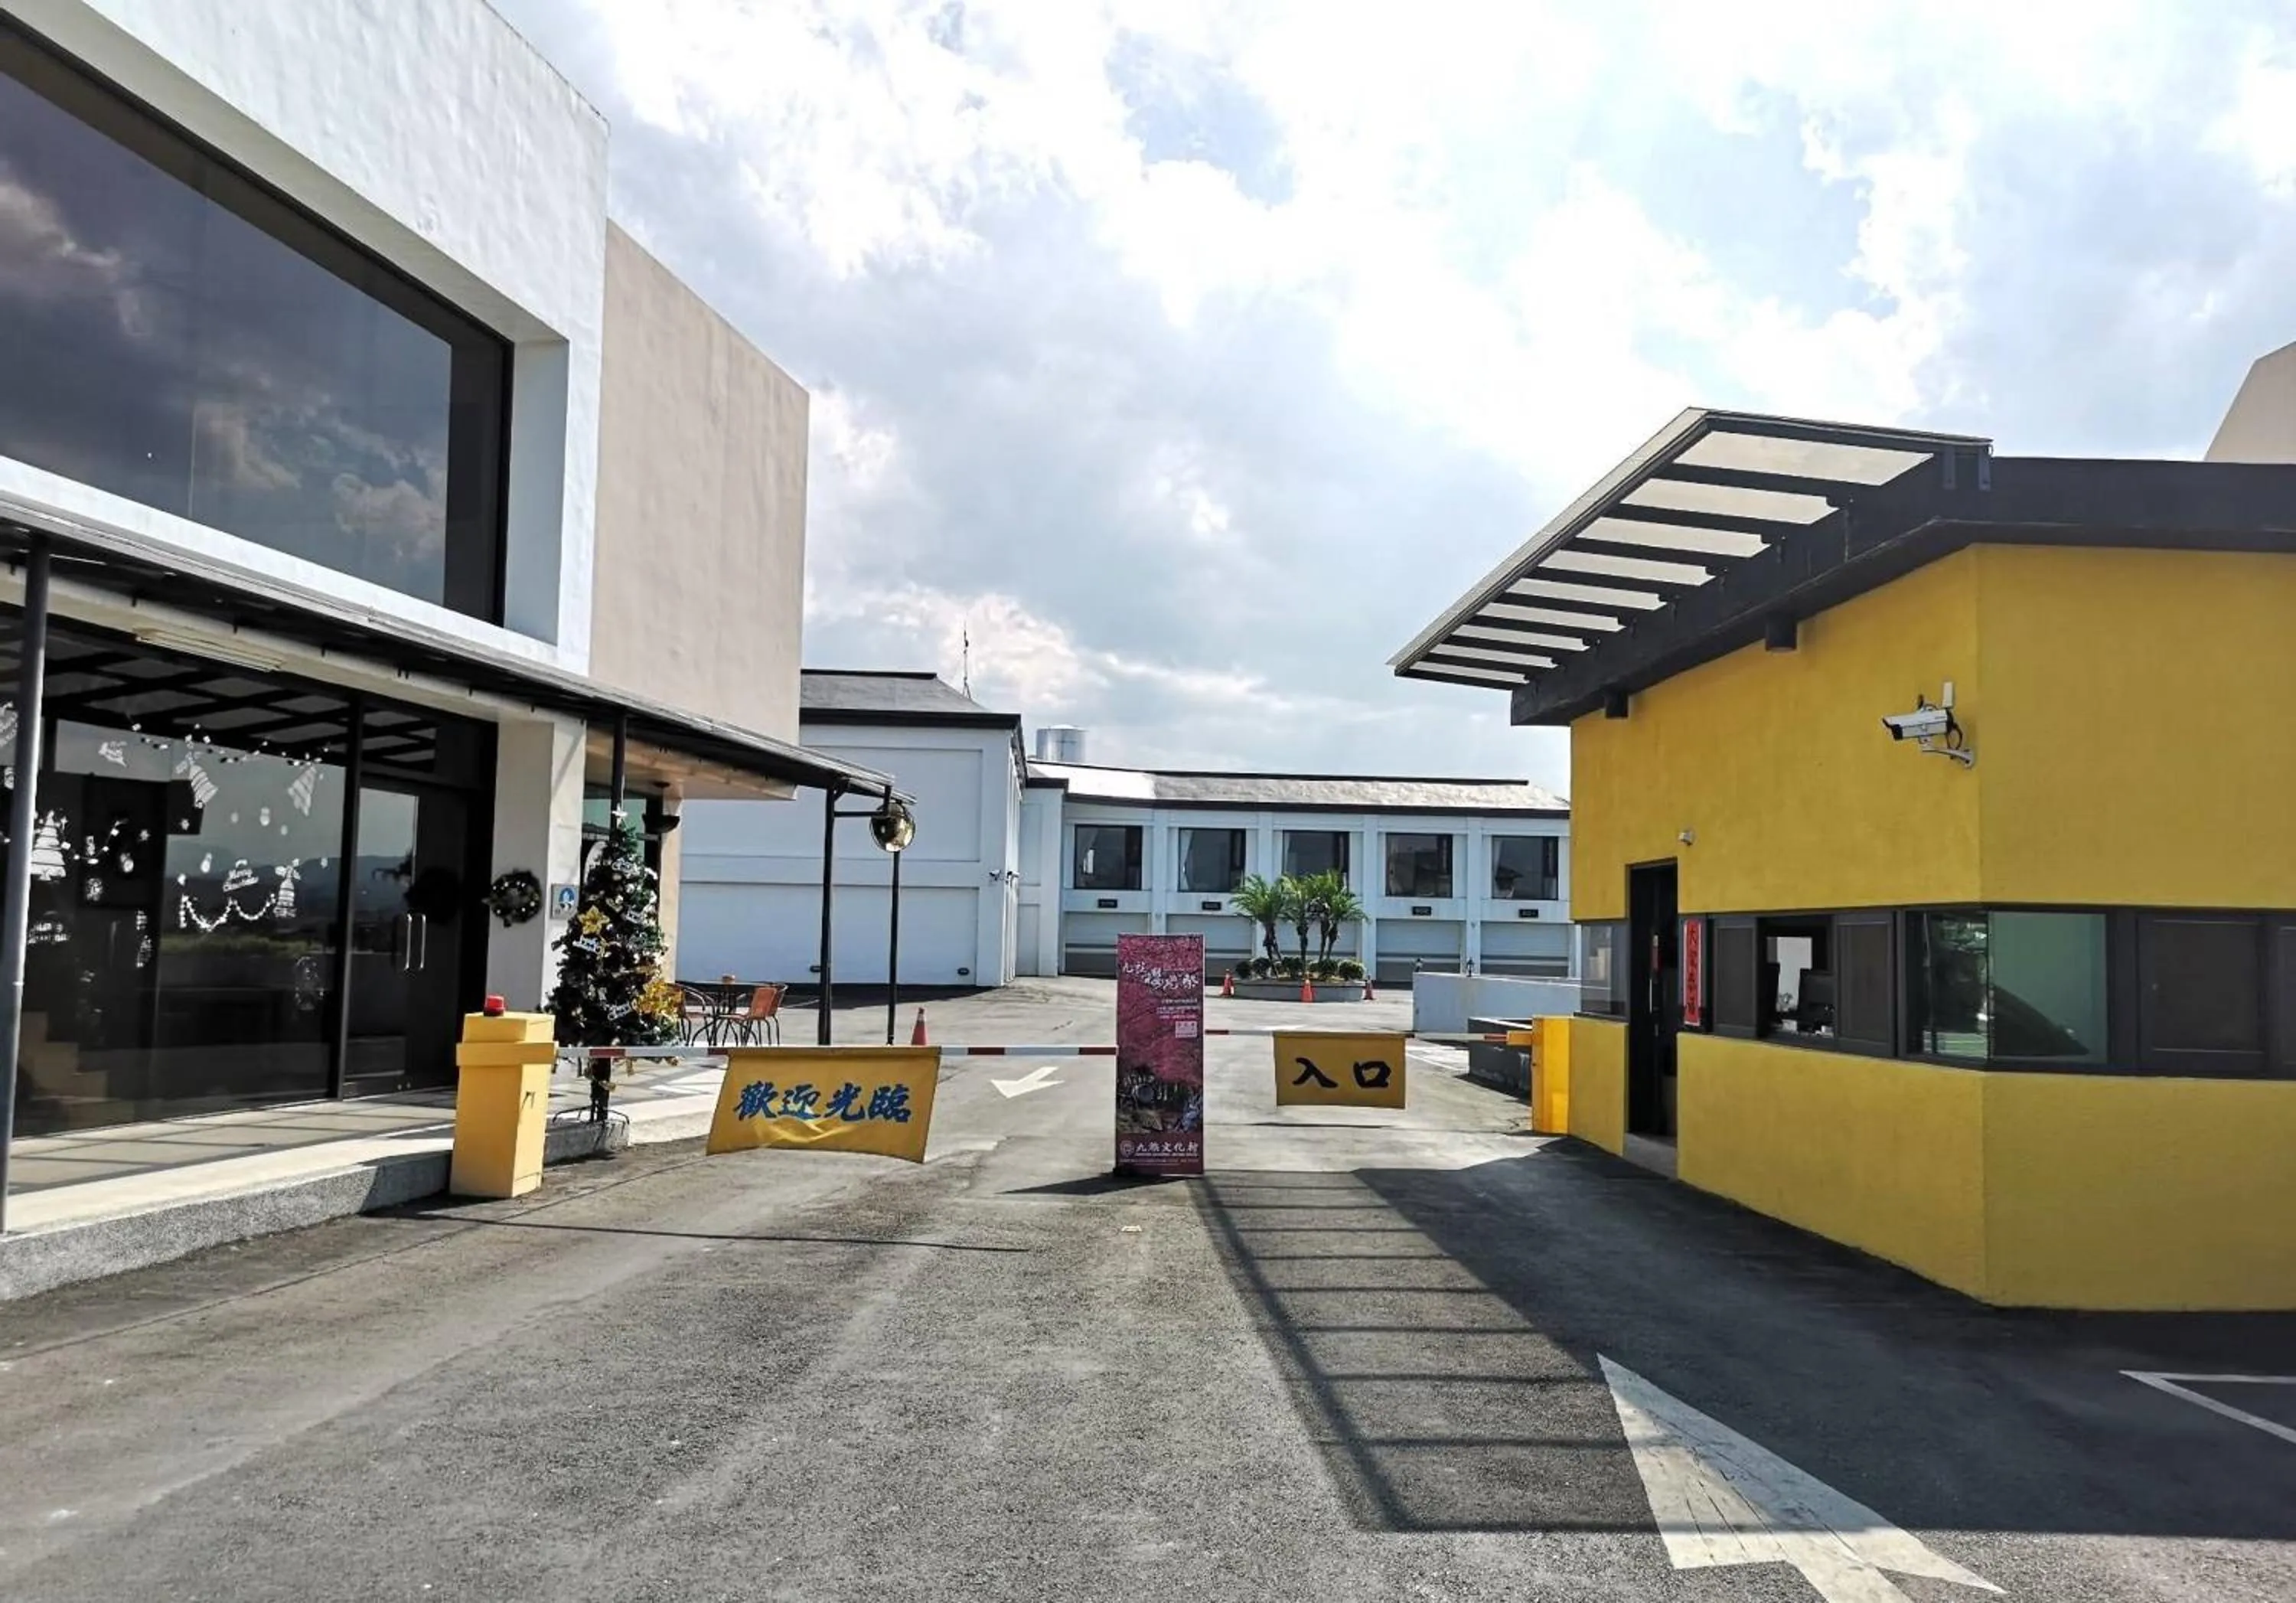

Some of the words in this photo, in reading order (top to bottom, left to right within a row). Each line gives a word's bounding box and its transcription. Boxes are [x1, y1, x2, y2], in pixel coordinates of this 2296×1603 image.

[1292, 1056, 1392, 1089] 入口
[733, 1080, 912, 1123] 歡迎光臨
[1136, 1141, 1199, 1153] 九族文化村
